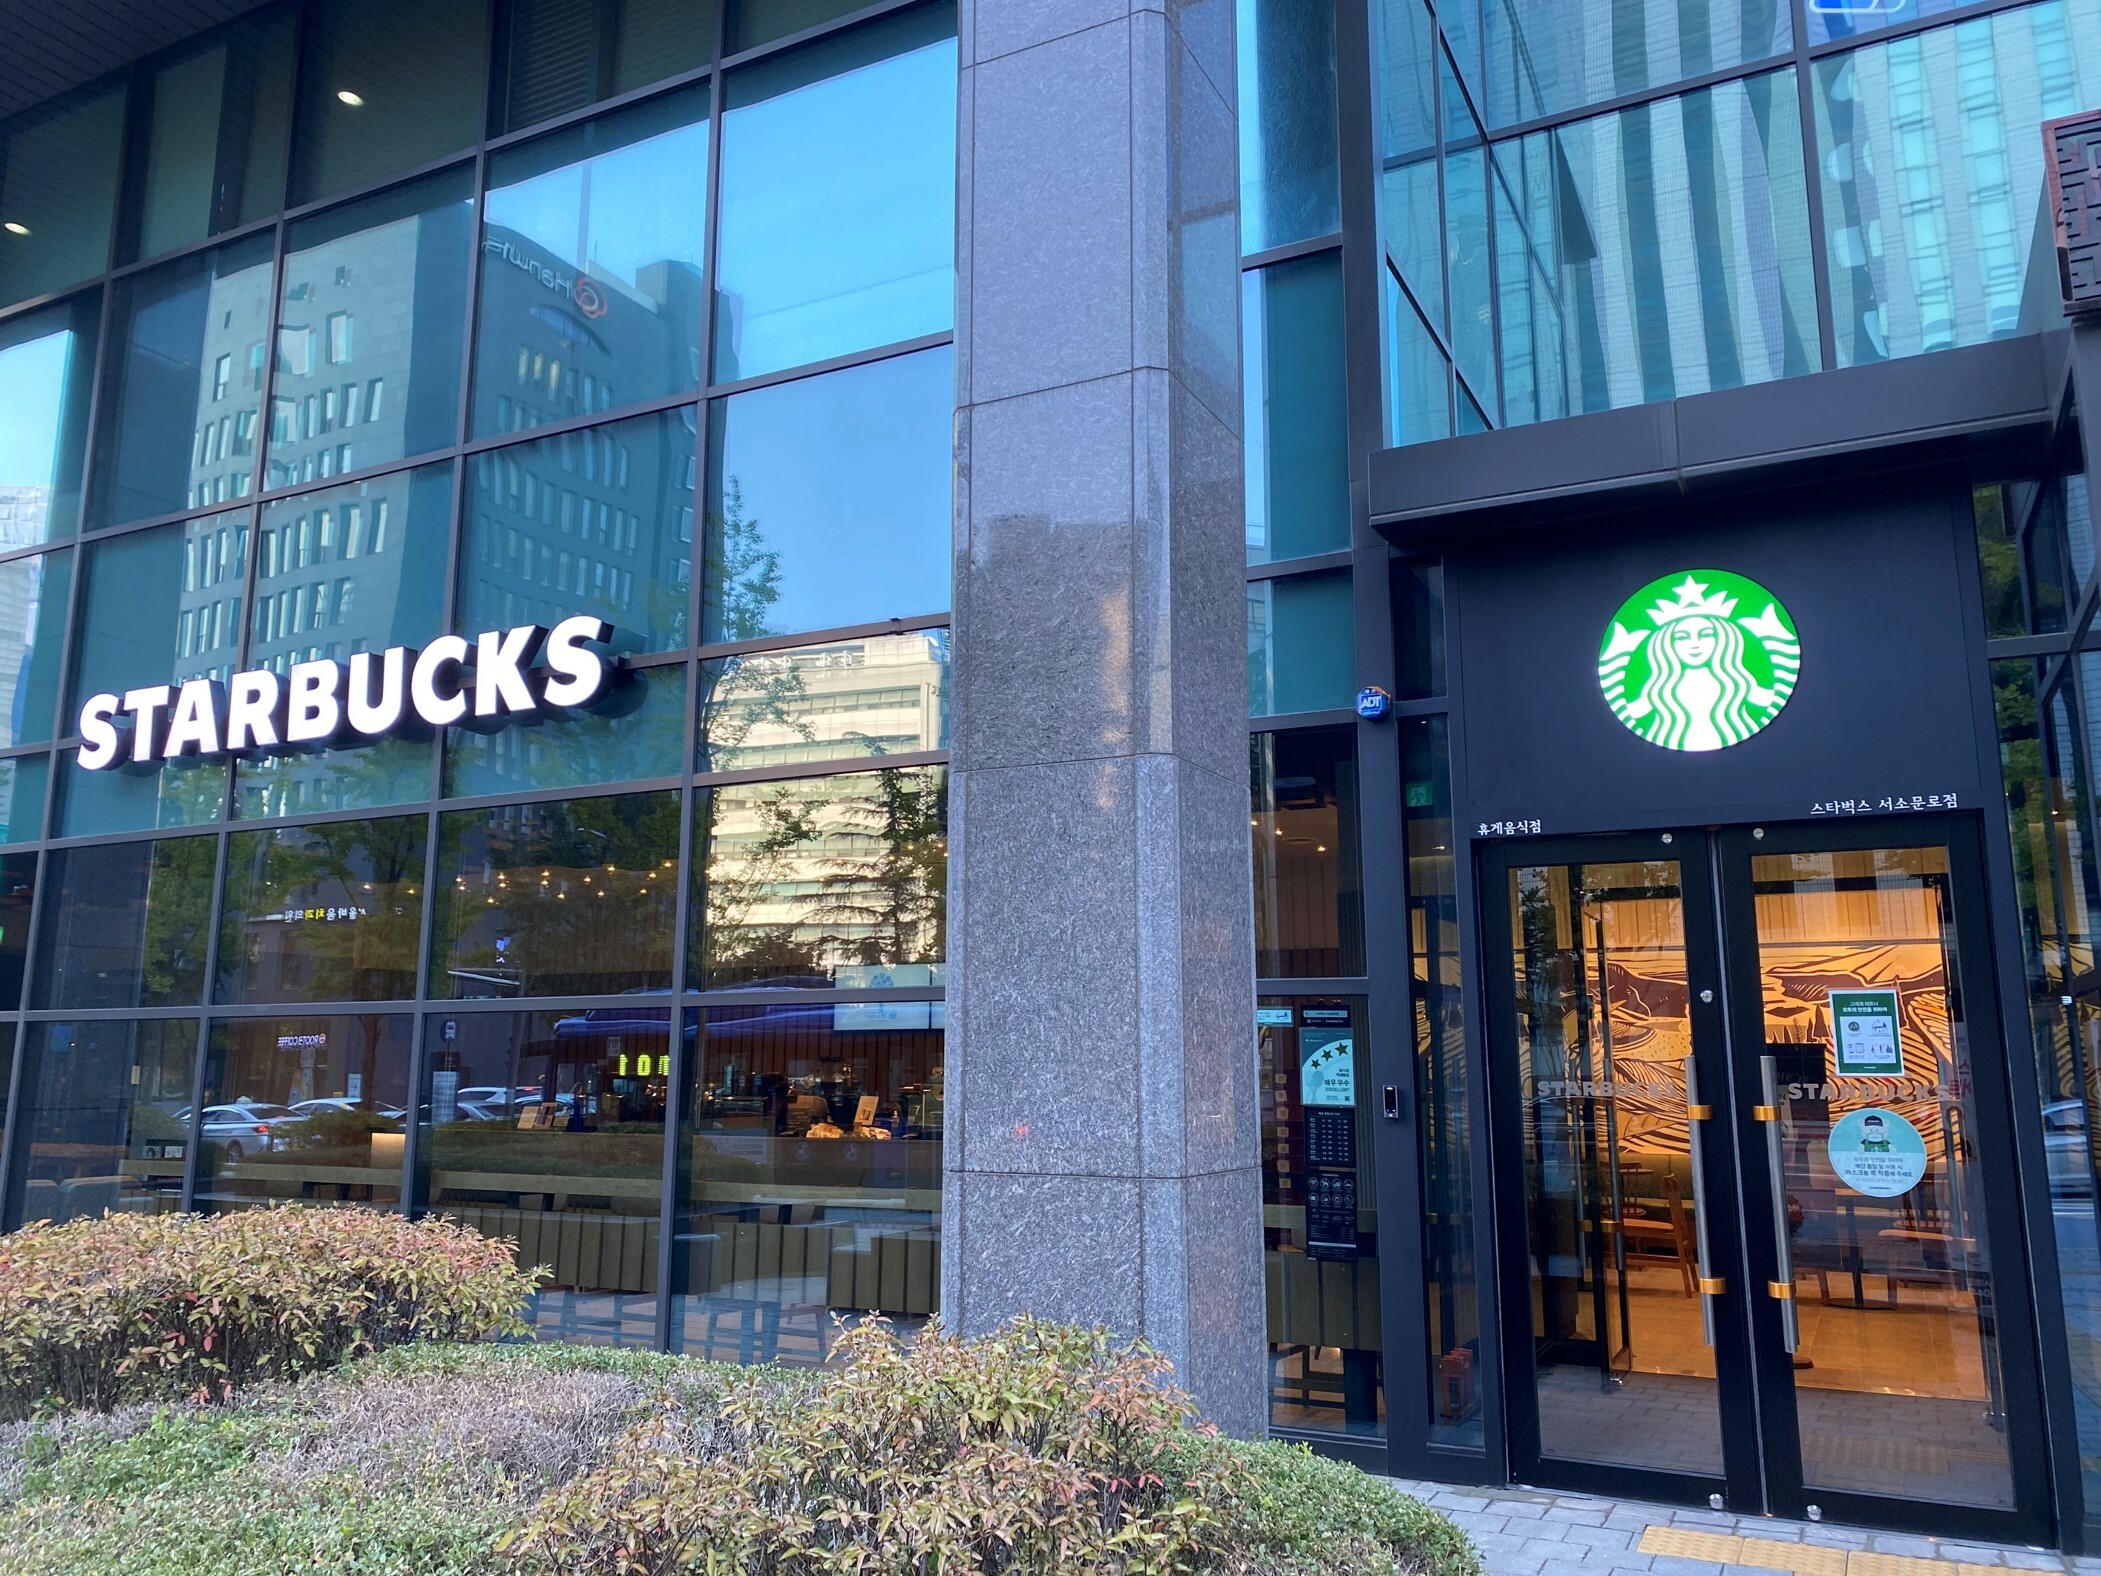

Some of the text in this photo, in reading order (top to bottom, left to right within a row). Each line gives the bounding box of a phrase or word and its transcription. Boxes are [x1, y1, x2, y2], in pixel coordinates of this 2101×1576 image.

[76, 615, 608, 771] STARBUCKS
[1360, 695, 1382, 709] ADT
[1810, 792, 1959, 815] 스타벅스 서소문로점
[1477, 819, 1541, 836] 휴게음식점
[1537, 1080, 1679, 1097] STARBUCKS
[1788, 1083, 1950, 1101] STARBUCKS
